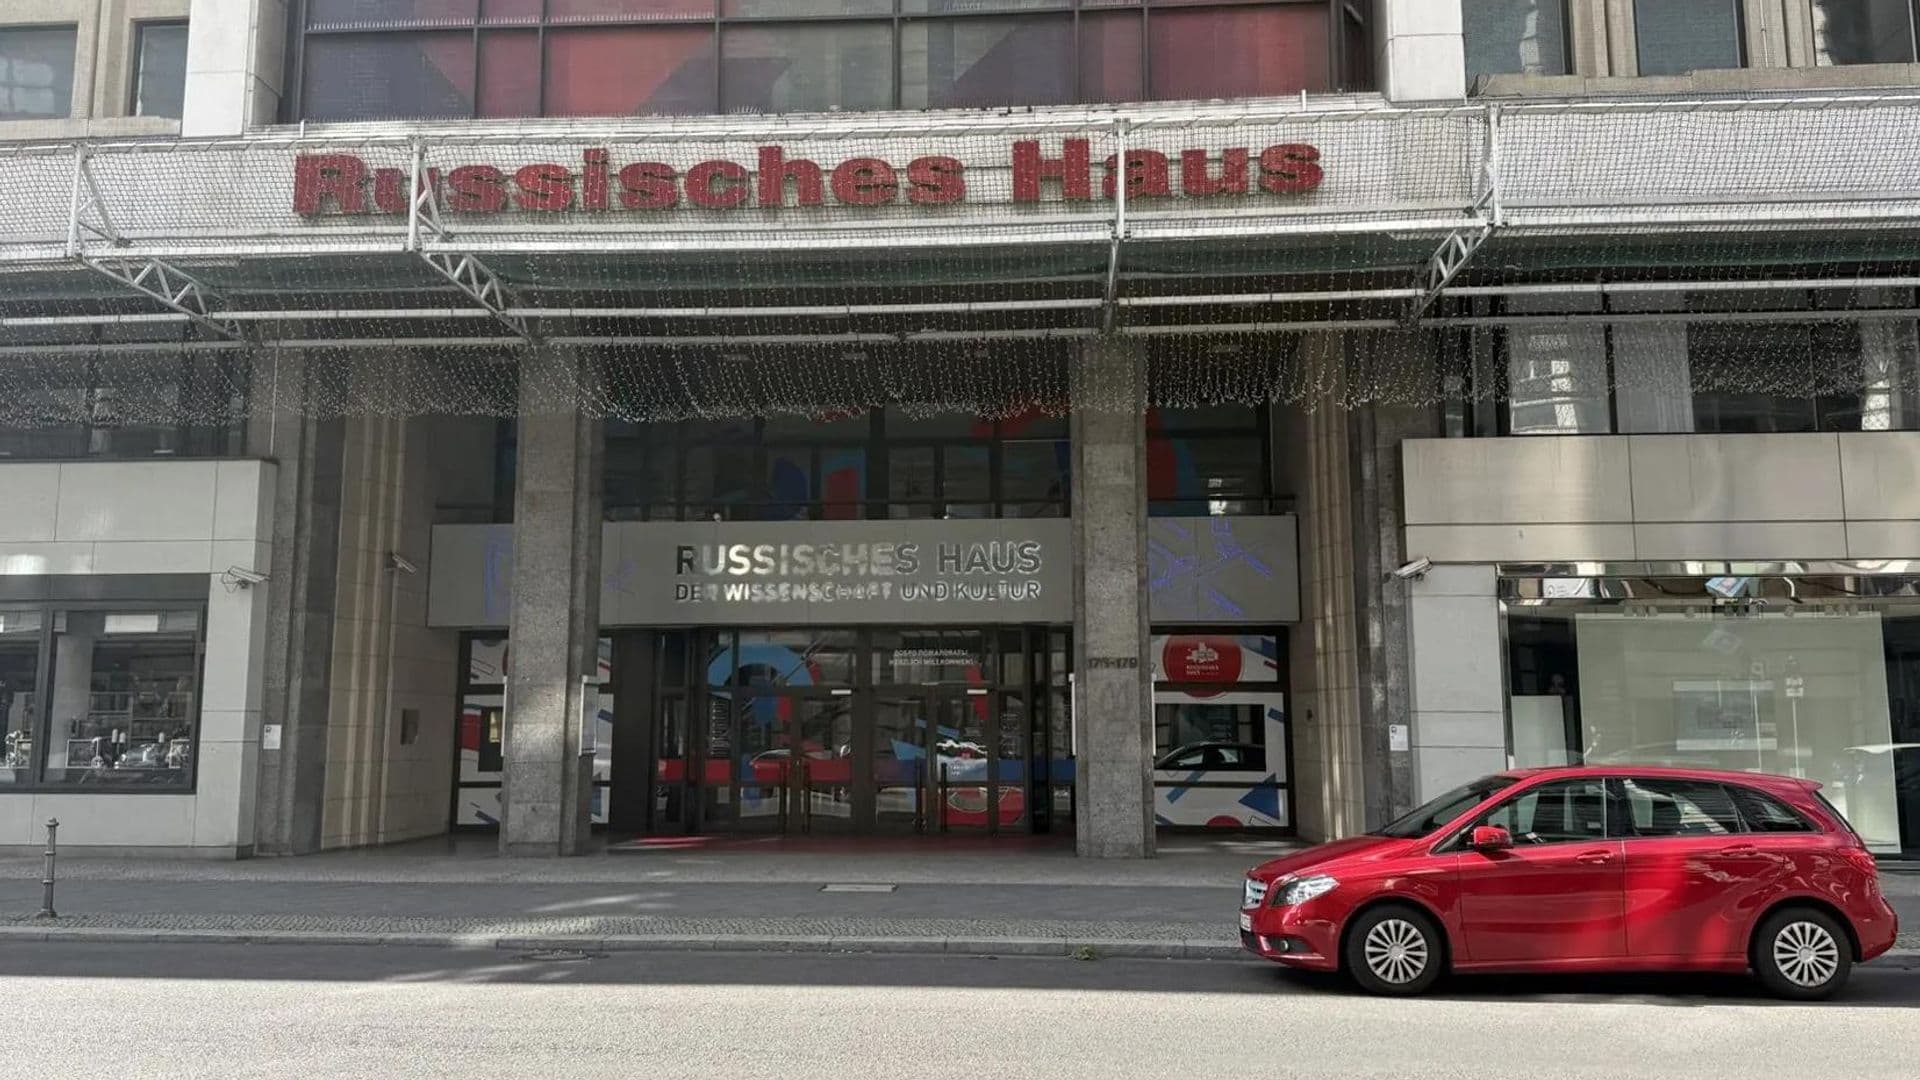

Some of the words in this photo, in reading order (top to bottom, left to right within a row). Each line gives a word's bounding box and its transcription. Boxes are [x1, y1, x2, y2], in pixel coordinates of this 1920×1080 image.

[293, 145, 967, 217] Russisches
[1012, 138, 1325, 203] Haus
[676, 543, 920, 576] RUSSISCHES
[936, 541, 1042, 575] HAUS
[675, 583, 719, 602] DER
[723, 582, 892, 602] WISSENSCHAFT
[901, 581, 949, 601] UND
[953, 581, 1042, 601] KULTUR
